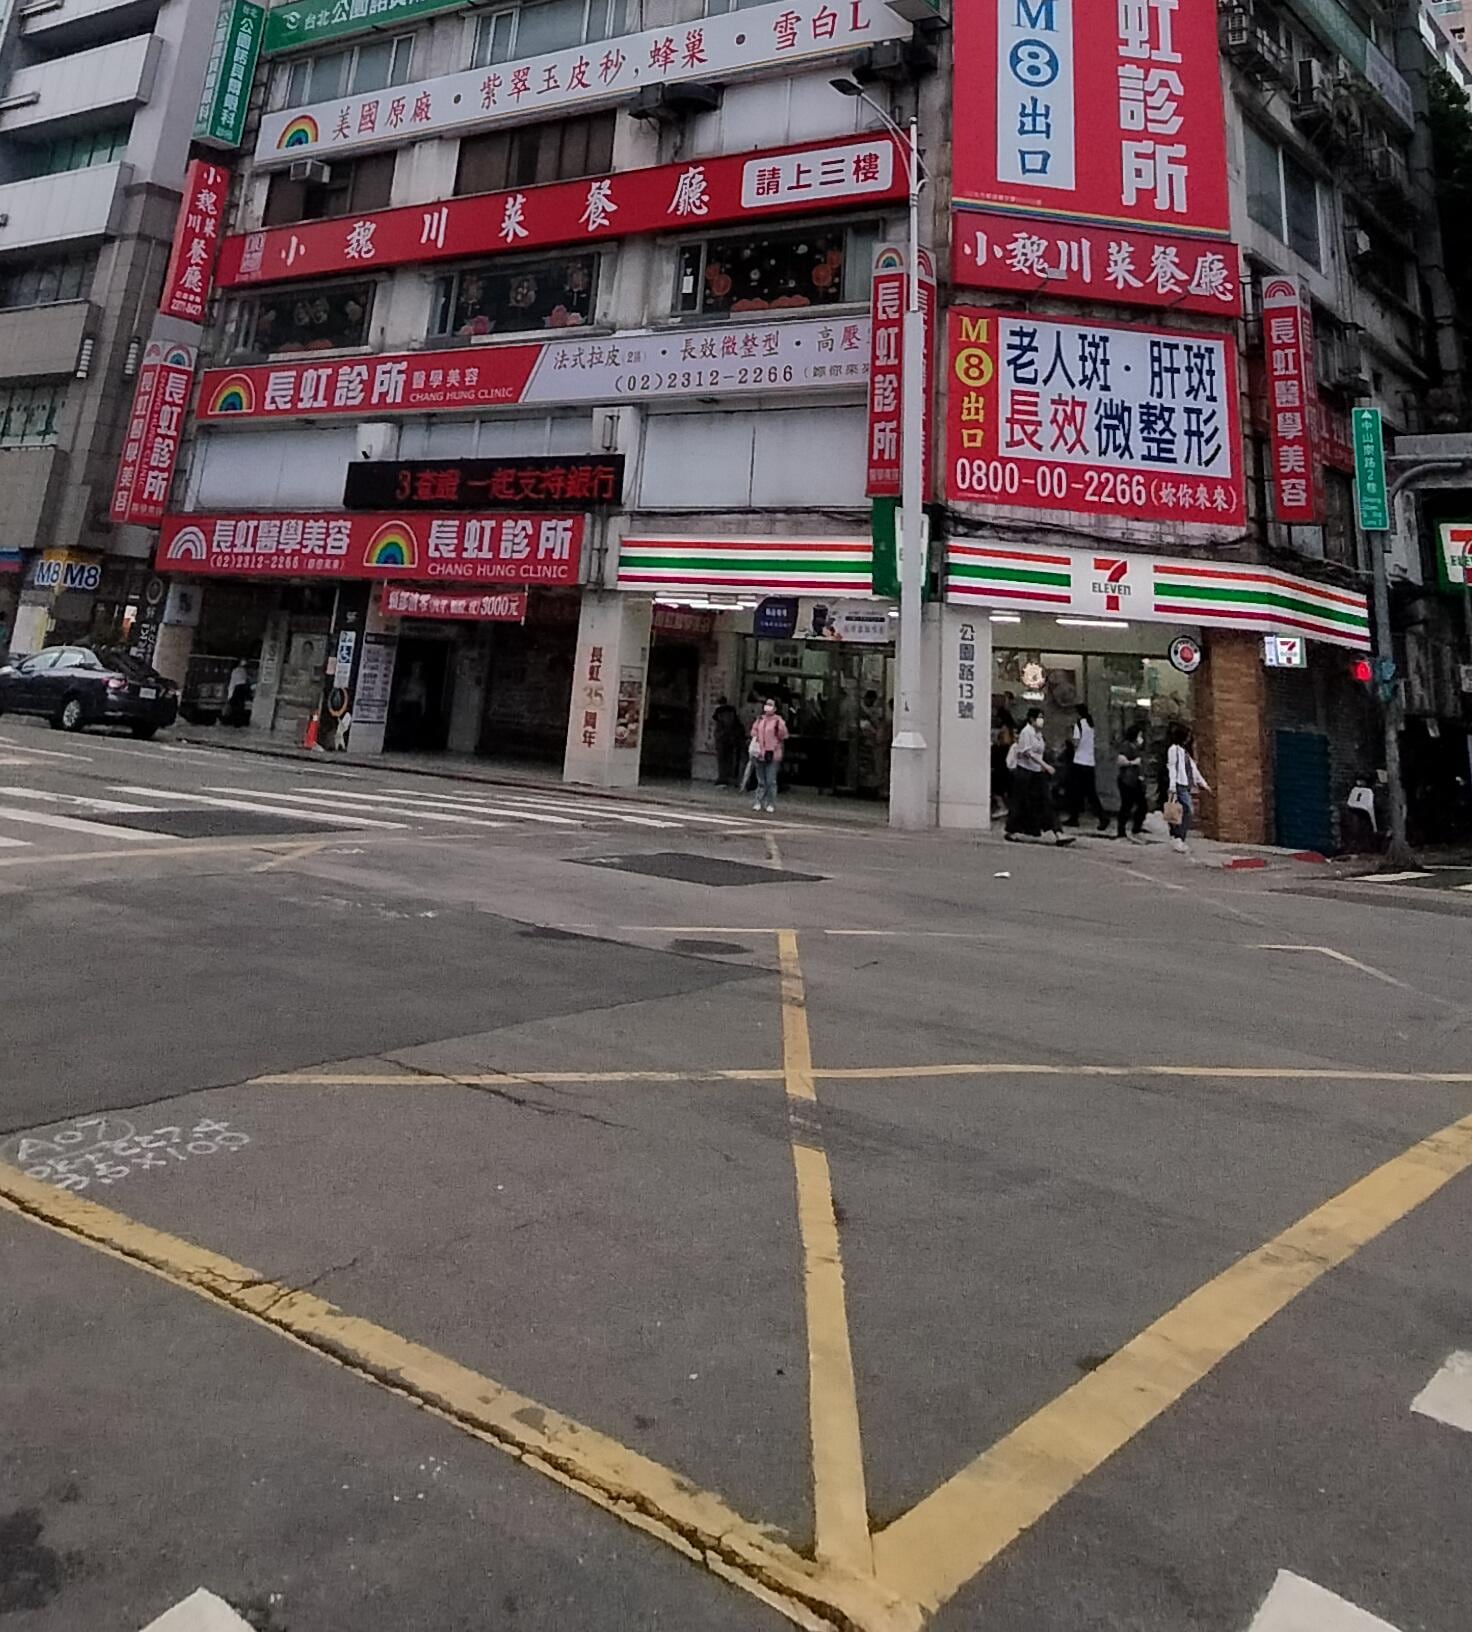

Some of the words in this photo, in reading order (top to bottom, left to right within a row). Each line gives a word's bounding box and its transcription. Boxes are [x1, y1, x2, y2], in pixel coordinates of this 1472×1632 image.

[331, 90, 433, 141] 美國原廠
[772, 0, 872, 52] 雪白L
[281, 165, 711, 266] 小魏川菜餐廳
[755, 152, 880, 200] 請上三樓
[962, 230, 1235, 302] 小魏川菜餐廳
[553, 344, 621, 371] 法式拉皮
[679, 329, 780, 361] 長效微整型
[817, 324, 870, 352] 高壓
[871, 281, 901, 462] 長虹診所
[1005, 326, 1112, 391] 老人斑
[1147, 338, 1218, 405] 肝斑
[263, 361, 409, 412] 長虹診所
[411, 367, 480, 389] 醫學美容
[409, 389, 443, 403] CHANG
[445, 389, 475, 402] HUNG
[477, 386, 513, 401] CLINIC
[614, 364, 794, 394] (02)2312-2266
[142, 371, 189, 502] 長虹診所
[1004, 390, 1222, 470] 長效微整形
[1269, 317, 1308, 509] 長虹醫學美容
[956, 456, 1147, 505] 0800-00-2266
[211, 519, 353, 556] 長虹醫學美容
[427, 518, 574, 560] 長虹診所
[36, 561, 60, 584] M8
[64, 563, 99, 588] M8
[427, 563, 474, 577] CHANG
[476, 564, 516, 578] HUNG
[519, 565, 569, 579] CLINIC
